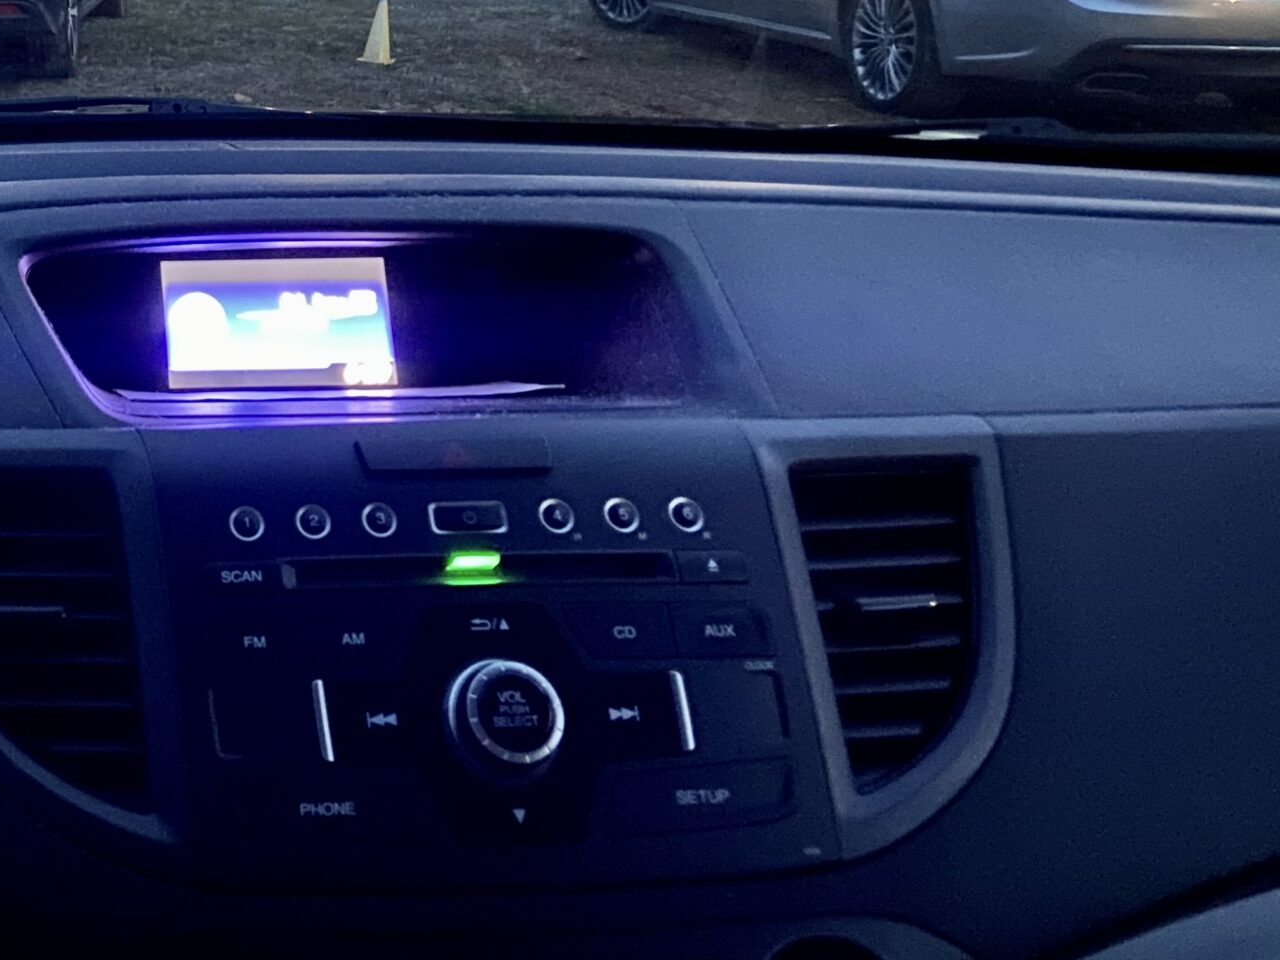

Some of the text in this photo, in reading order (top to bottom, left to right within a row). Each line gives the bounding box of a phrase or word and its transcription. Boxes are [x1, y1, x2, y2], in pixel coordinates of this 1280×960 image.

[375, 512, 386, 524] 3
[553, 509, 563, 521] 4
[618, 508, 629, 520] 5
[682, 506, 693, 519] 6
[309, 514, 319, 526] 2
[221, 570, 262, 583] SCAN
[613, 625, 637, 639] CD
[704, 624, 736, 637] AUX
[243, 636, 266, 648] FM
[342, 632, 365, 645] AM
[497, 690, 526, 702] VOL
[493, 715, 538, 727] SELECT
[675, 788, 730, 806] SETUP
[300, 800, 356, 817] PHONE
